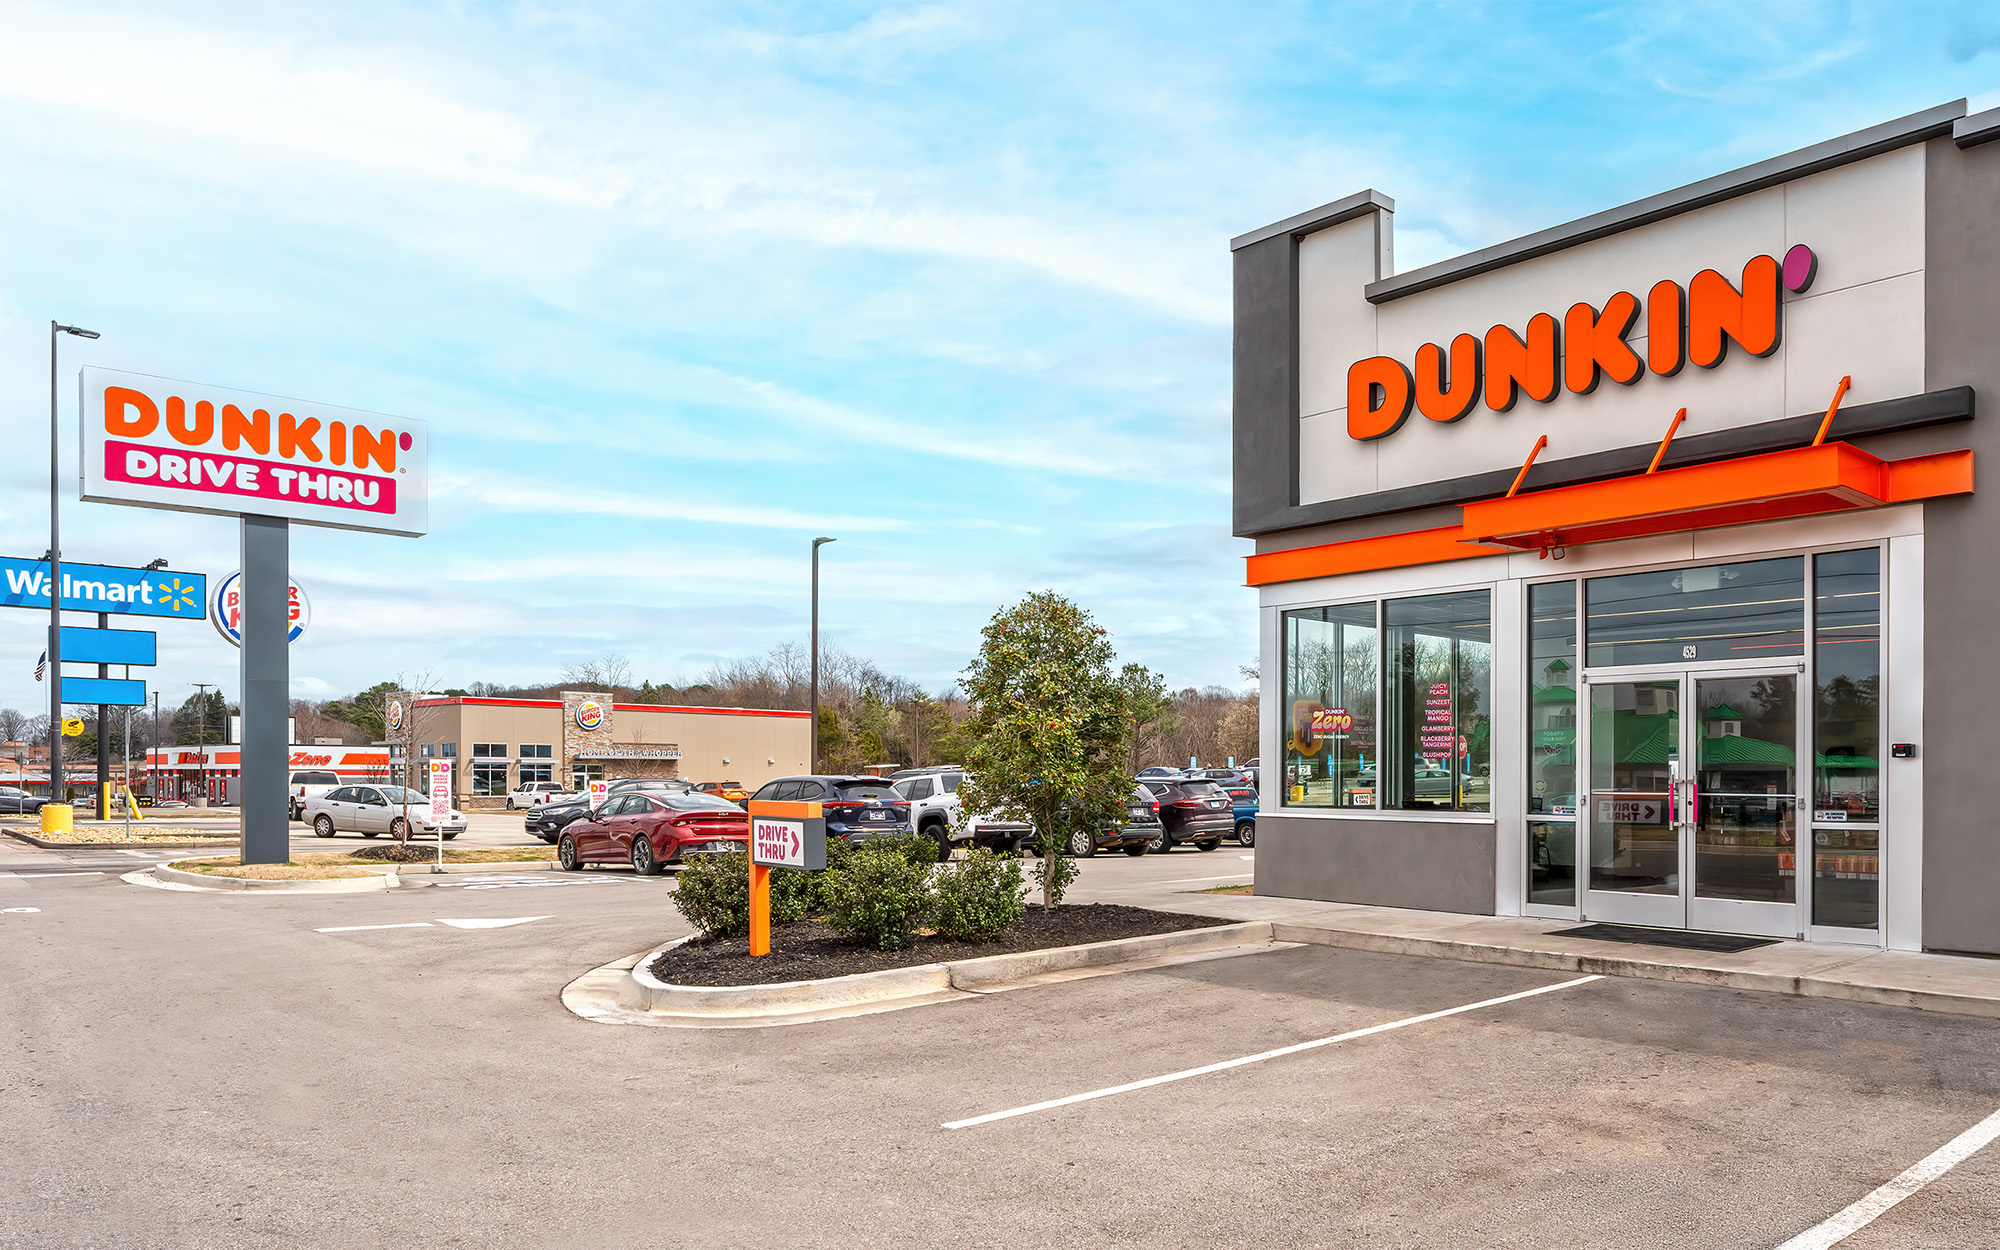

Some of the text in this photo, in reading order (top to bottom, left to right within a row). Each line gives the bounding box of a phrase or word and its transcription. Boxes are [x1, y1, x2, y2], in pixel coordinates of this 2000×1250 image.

[1346, 242, 1819, 441] DUNKIN'
[104, 385, 413, 474] DUNKIN'
[125, 449, 380, 506] DRIVE THRU
[5, 568, 153, 605] Walmart
[1682, 644, 1697, 659] 4529
[581, 711, 601, 722] KING
[1311, 710, 1352, 730] Zero
[580, 748, 605, 756] HOME
[608, 748, 621, 756] OF
[642, 749, 683, 757] WHOPPER
[431, 763, 450, 773] DD
[590, 783, 607, 793] DD
[757, 824, 788, 843] DRIVE
[757, 842, 786, 861] THRU
